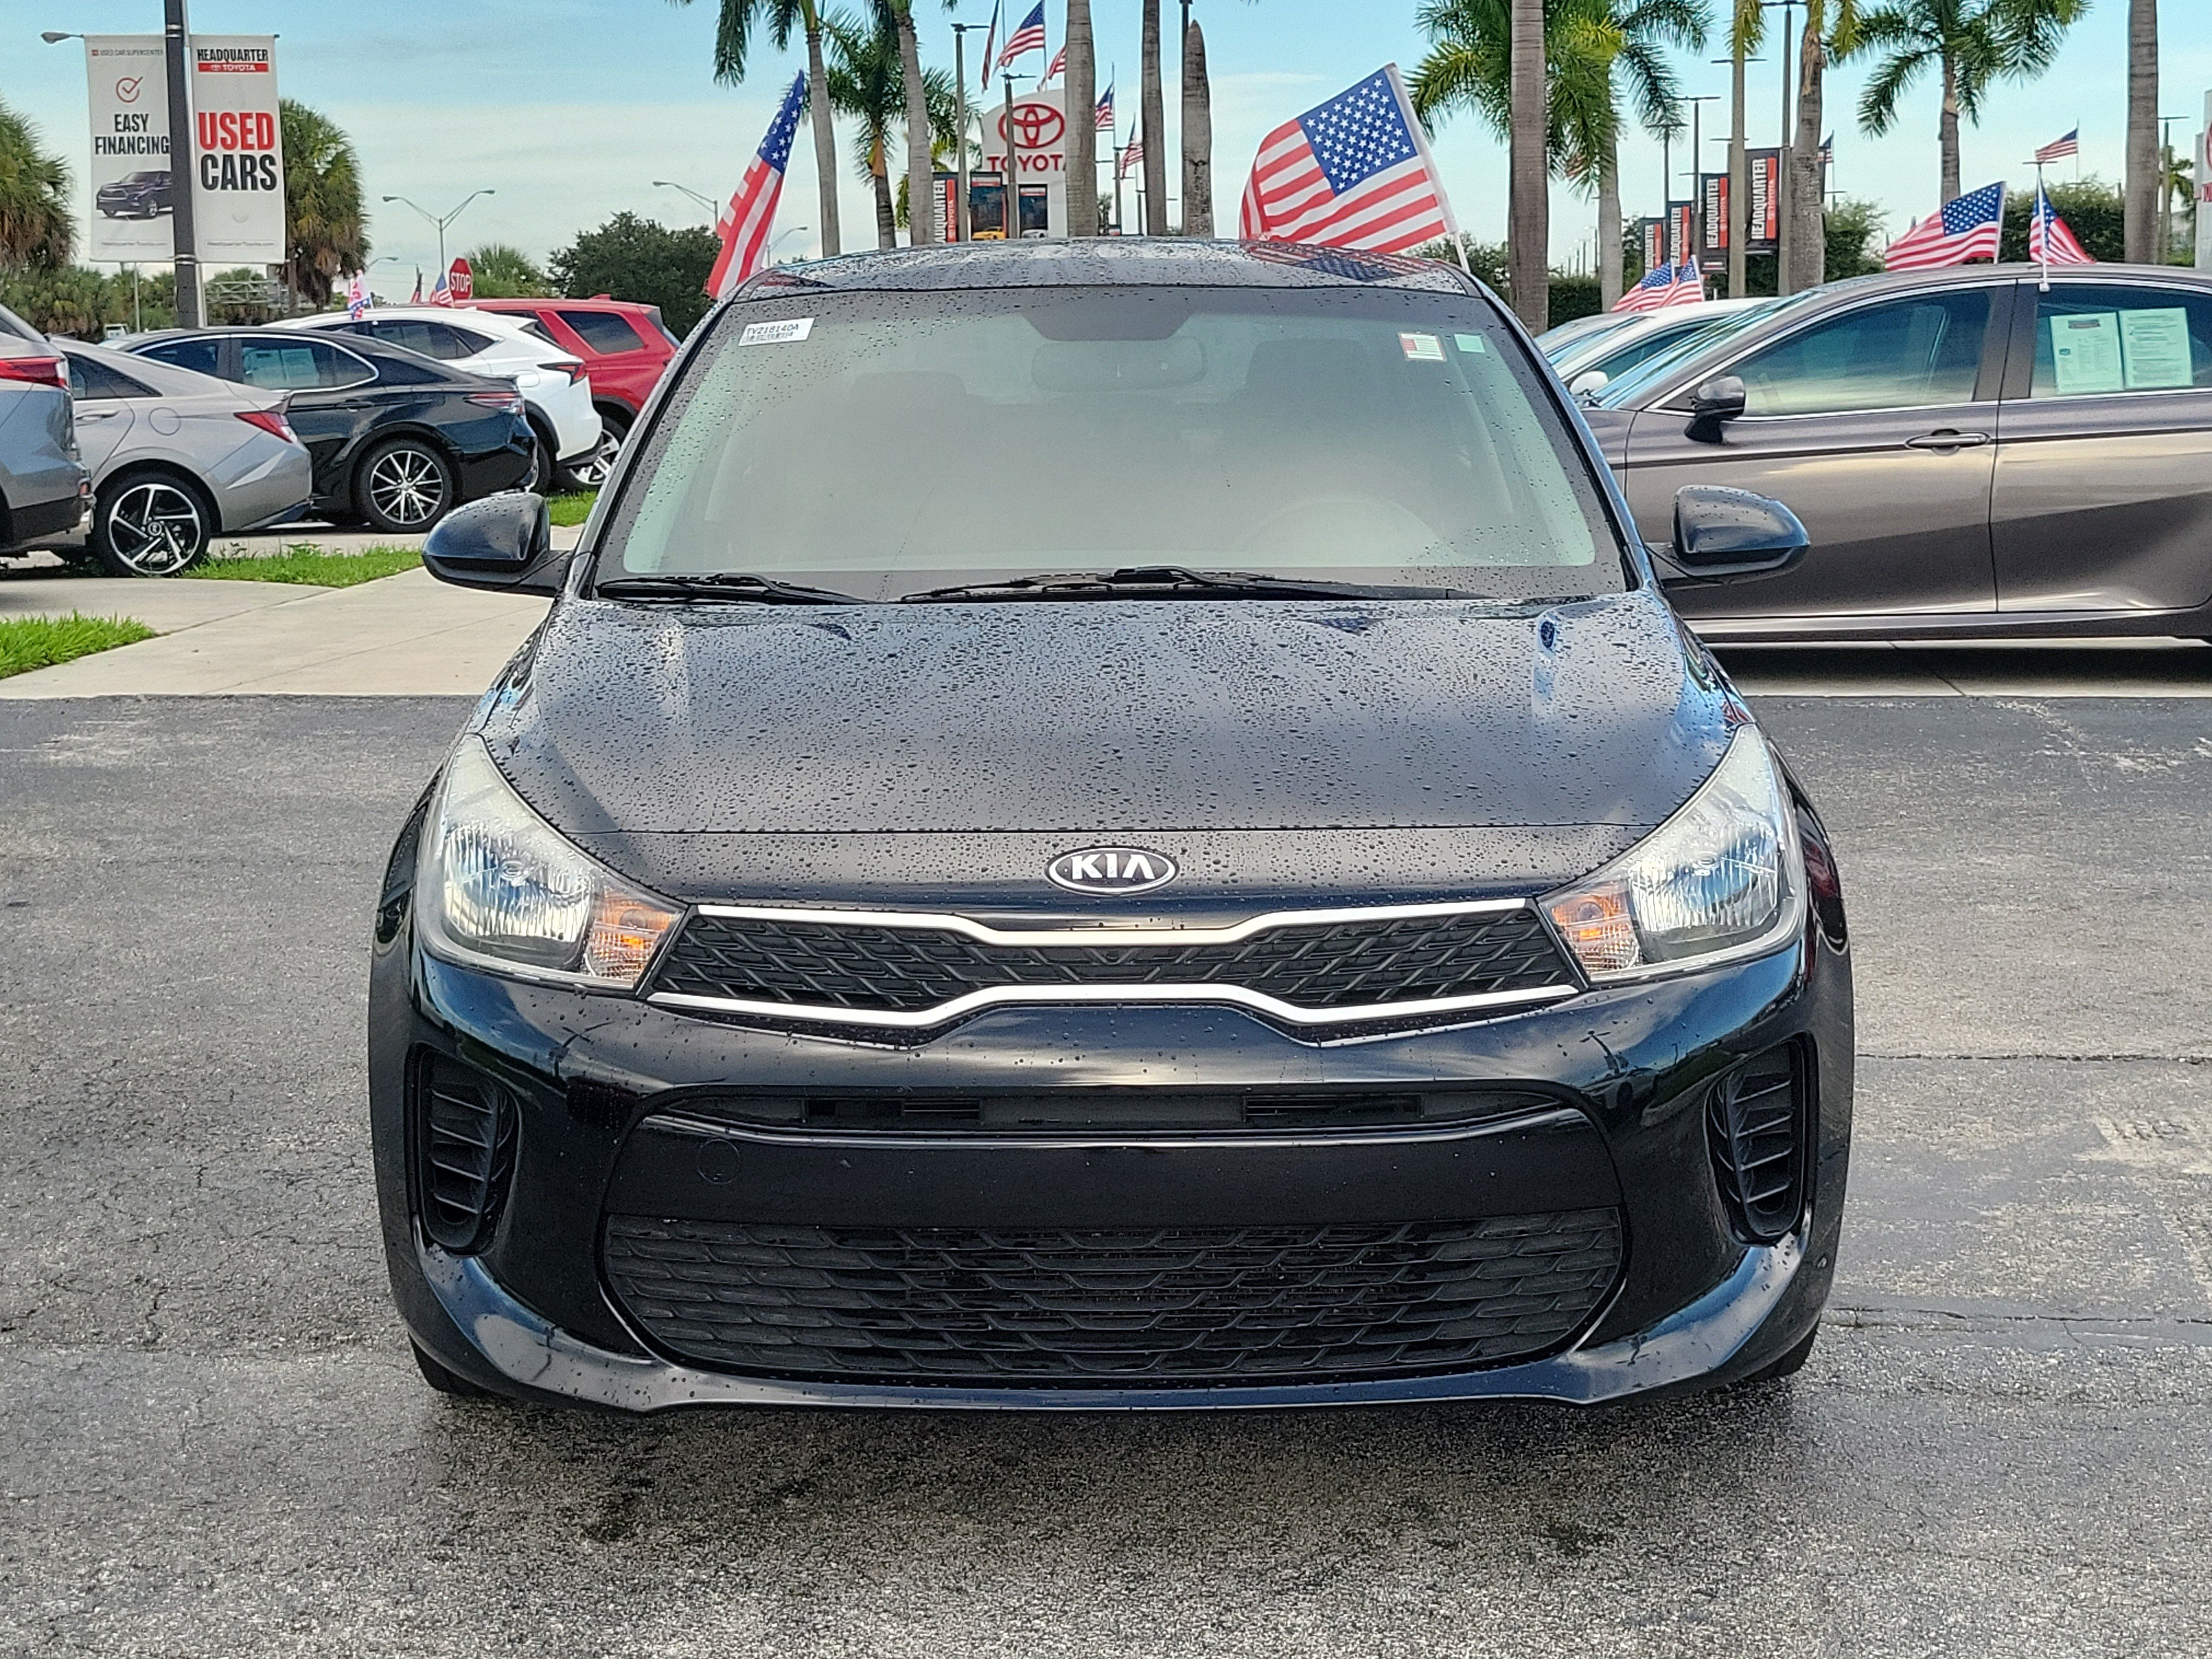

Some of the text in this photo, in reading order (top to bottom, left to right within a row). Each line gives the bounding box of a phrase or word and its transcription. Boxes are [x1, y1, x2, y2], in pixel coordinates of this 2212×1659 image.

[197, 49, 268, 63] HEADQUARTER
[114, 114, 149, 132] EASY
[198, 112, 275, 150] USED
[95, 136, 170, 155] FINANCING
[201, 154, 277, 190] CARS
[987, 154, 1066, 172] TOYOT
[934, 180, 947, 244] ADQUARTER
[1752, 159, 1767, 239] HEADQUARTER
[1707, 179, 1719, 248] HEADQUARTER
[450, 272, 471, 292] STOP
[1070, 853, 1155, 880] KIA
